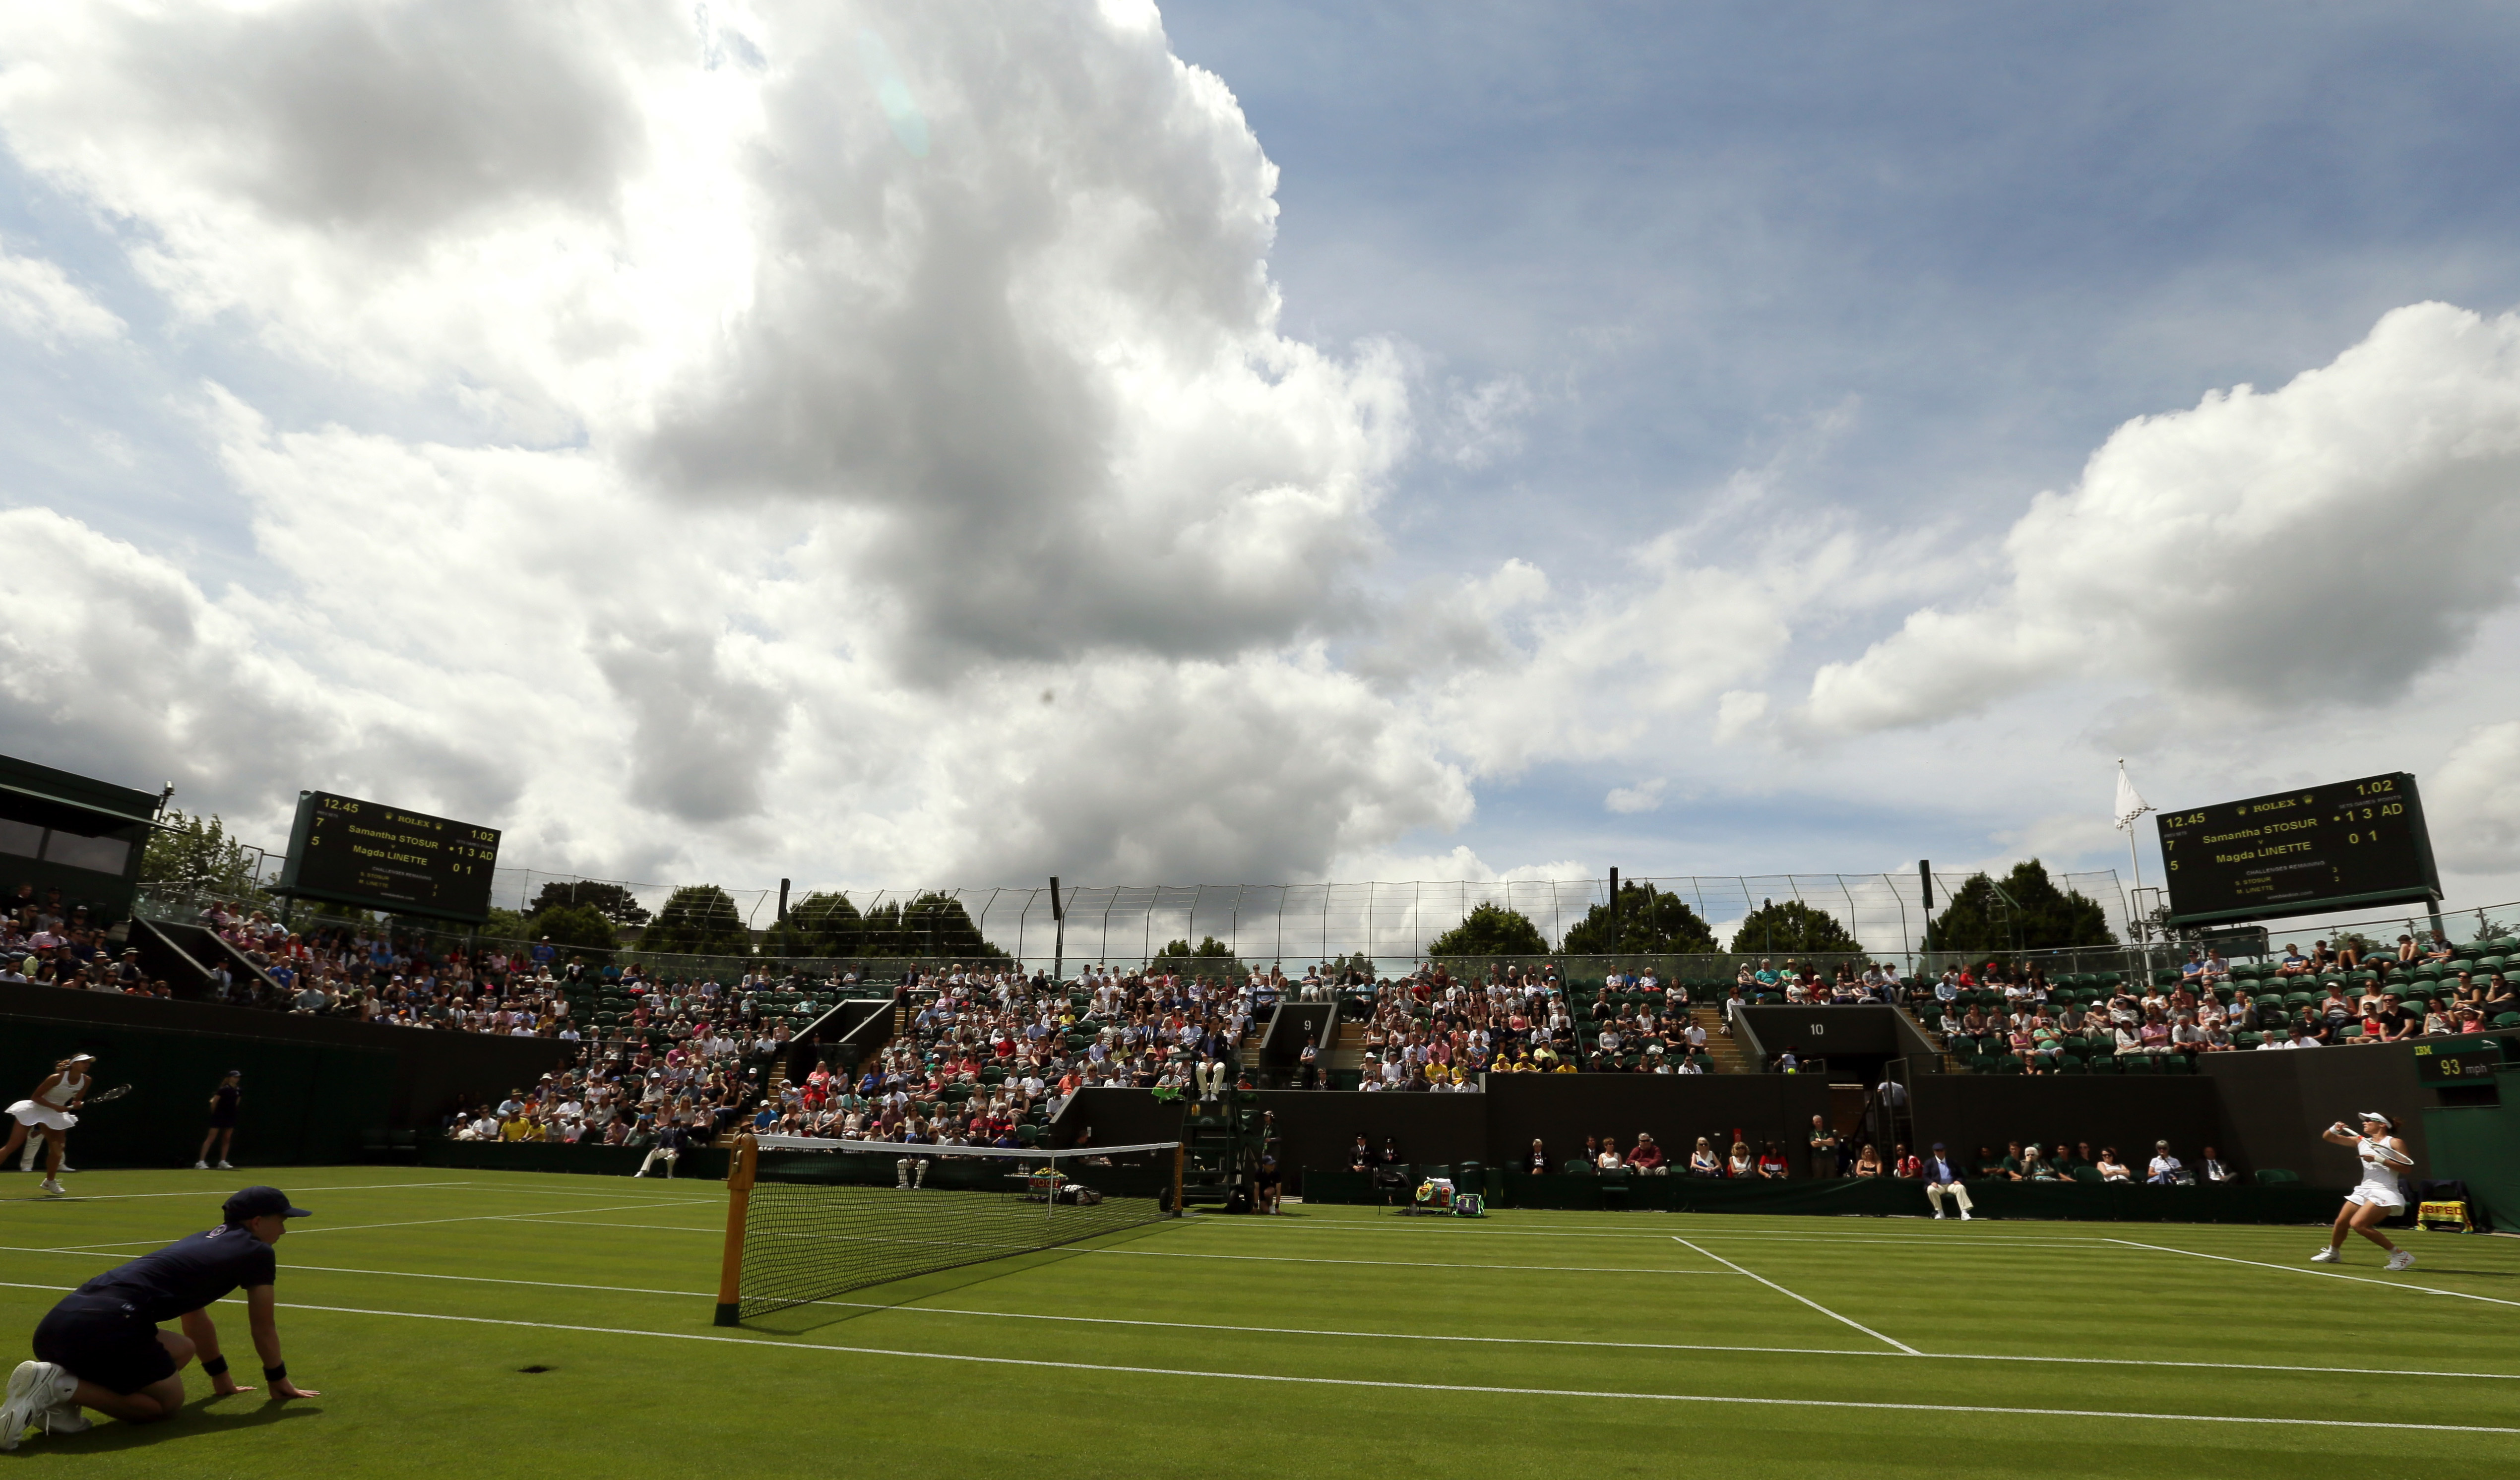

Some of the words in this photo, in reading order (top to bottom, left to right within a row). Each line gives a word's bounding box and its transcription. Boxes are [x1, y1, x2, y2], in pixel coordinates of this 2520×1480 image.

[2356, 780, 2394, 796] 1.02
[324, 798, 359, 813] 12.45
[2253, 799, 2297, 812] ROLEX
[2346, 811, 2354, 821] 1
[2362, 808, 2373, 819] 3
[2382, 803, 2402, 816] AD
[316, 817, 324, 827] 7
[397, 815, 430, 828] ROLEX
[2166, 813, 2205, 828] 12.45
[349, 825, 396, 841] Samantha
[399, 835, 439, 850] STOSUR
[471, 830, 494, 842] 1.02
[2203, 829, 2261, 844] Samantha
[2264, 818, 2318, 834] STOSUR
[2348, 833, 2359, 844] 0
[2368, 830, 2377, 841] 1
[311, 836, 320, 845] 5
[2166, 840, 2175, 851] 7
[353, 845, 385, 857] Magda
[387, 852, 428, 865] LINETTE
[458, 846, 463, 855] 1
[468, 848, 475, 857] 3
[479, 851, 494, 860] AD
[2216, 851, 2255, 863] Magda
[2258, 842, 2312, 857] LINETTE
[453, 863, 460, 872] 0
[466, 866, 471, 874] 1
[2170, 861, 2178, 870] 5
[2246, 865, 2287, 875] CHALLENGES
[2289, 861, 2325, 869] REMAINING
[2243, 876, 2271, 885] STOSUR
[1304, 1020, 1311, 1030] 9
[1810, 1024, 1824, 1035] 10
[2414, 1046, 2432, 1055] IBM
[2441, 1059, 2461, 1075] 93
[2465, 1064, 2488, 1075] mph
